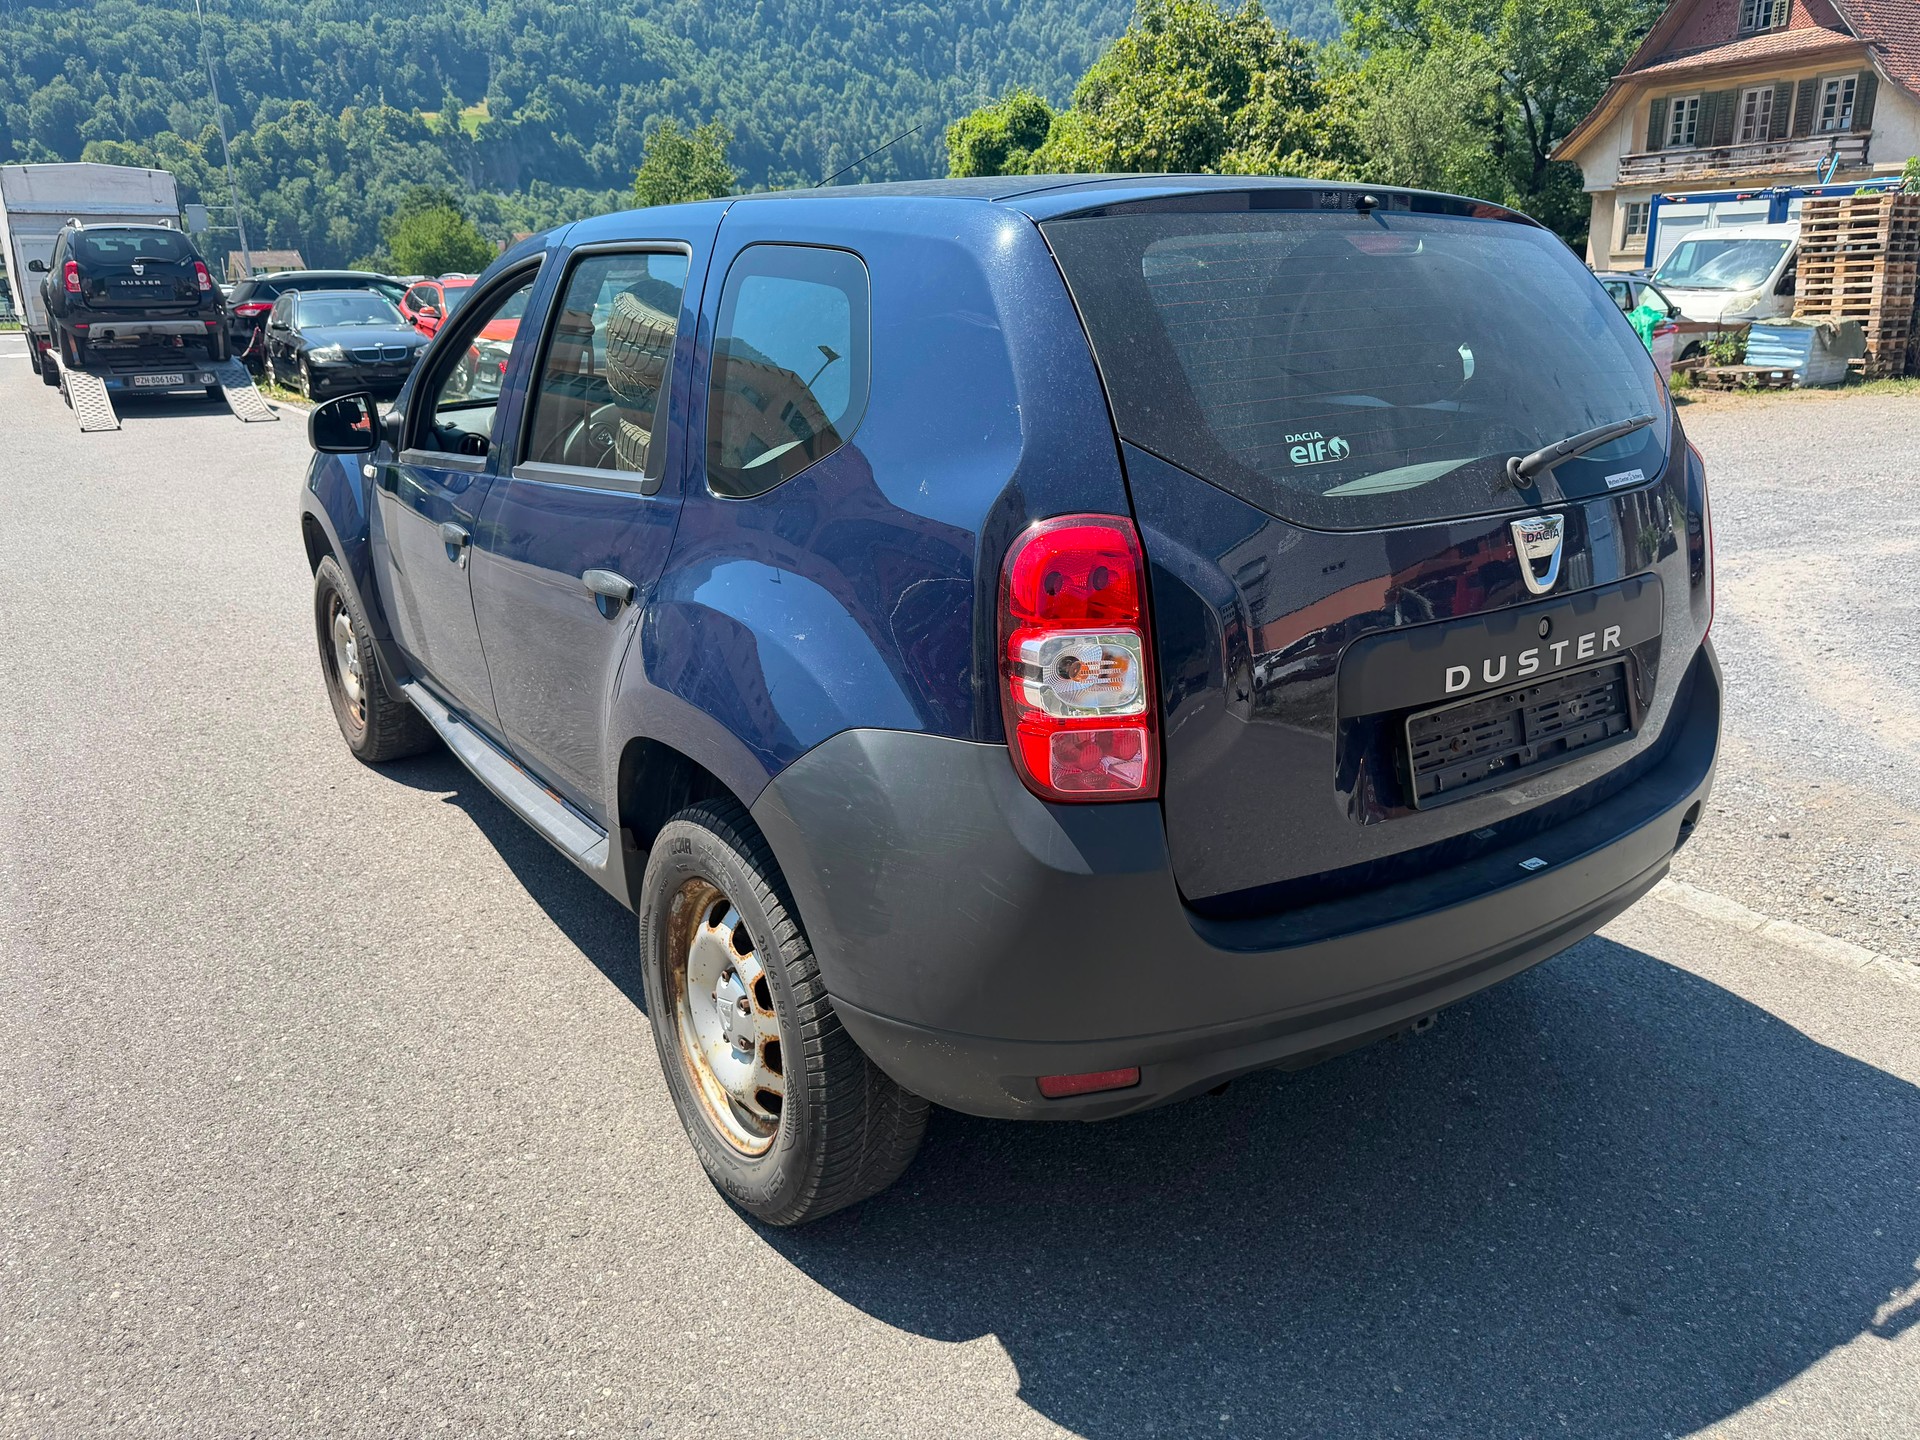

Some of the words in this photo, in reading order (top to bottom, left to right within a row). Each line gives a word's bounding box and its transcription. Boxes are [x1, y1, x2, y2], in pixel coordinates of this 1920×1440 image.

[203, 374, 213, 382] CH
[1285, 431, 1323, 443] DACIA
[1290, 441, 1327, 463] elf
[1526, 528, 1560, 543] DACIA
[1445, 625, 1621, 693] DUSTER
[758, 935, 781, 992] 215/65
[777, 1000, 791, 1030] R16
